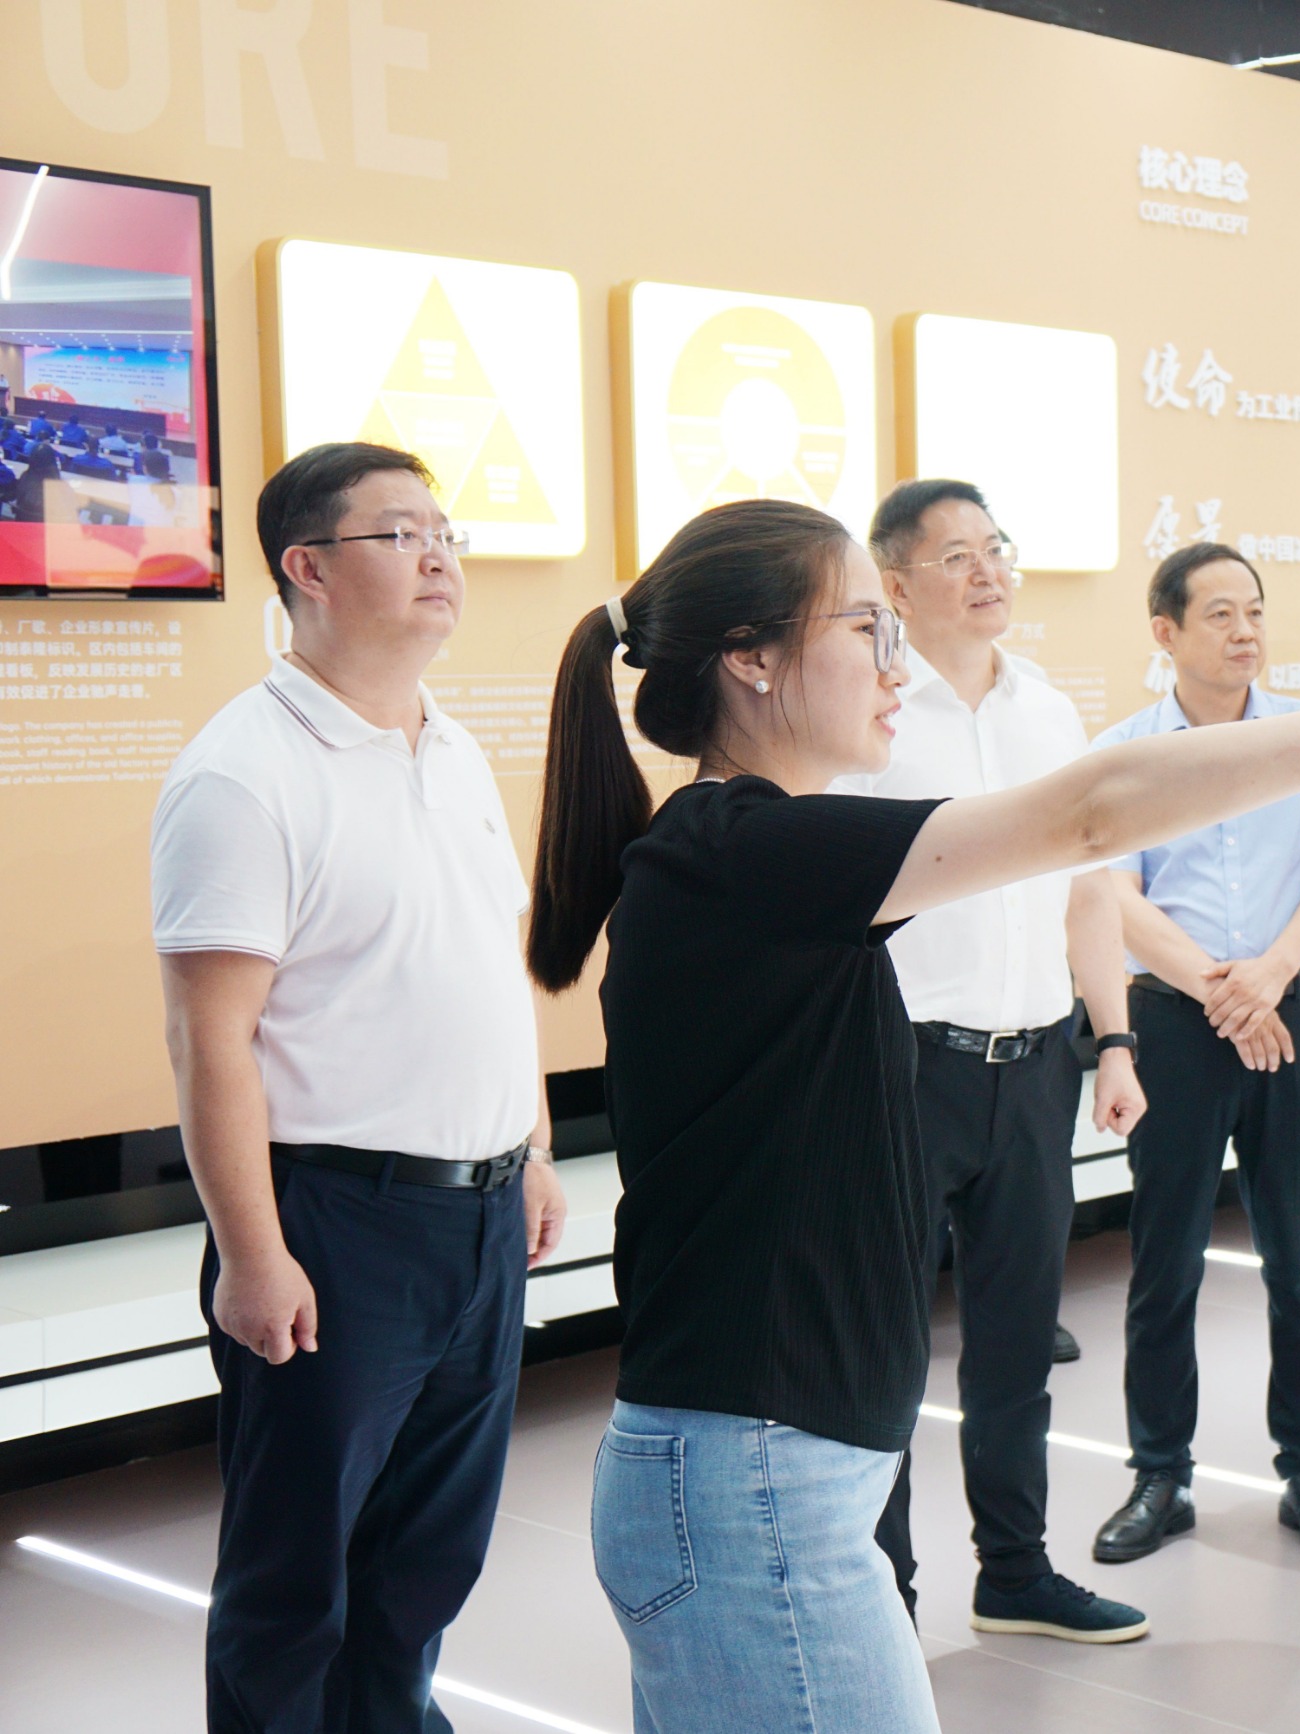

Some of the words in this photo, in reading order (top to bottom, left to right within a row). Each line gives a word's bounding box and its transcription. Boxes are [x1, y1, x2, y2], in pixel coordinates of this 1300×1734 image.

[1138, 144, 1249, 203] 核心理念
[1139, 200, 1181, 225] CORE
[1181, 206, 1249, 235] CONCEPT
[1141, 342, 1233, 417] 使命
